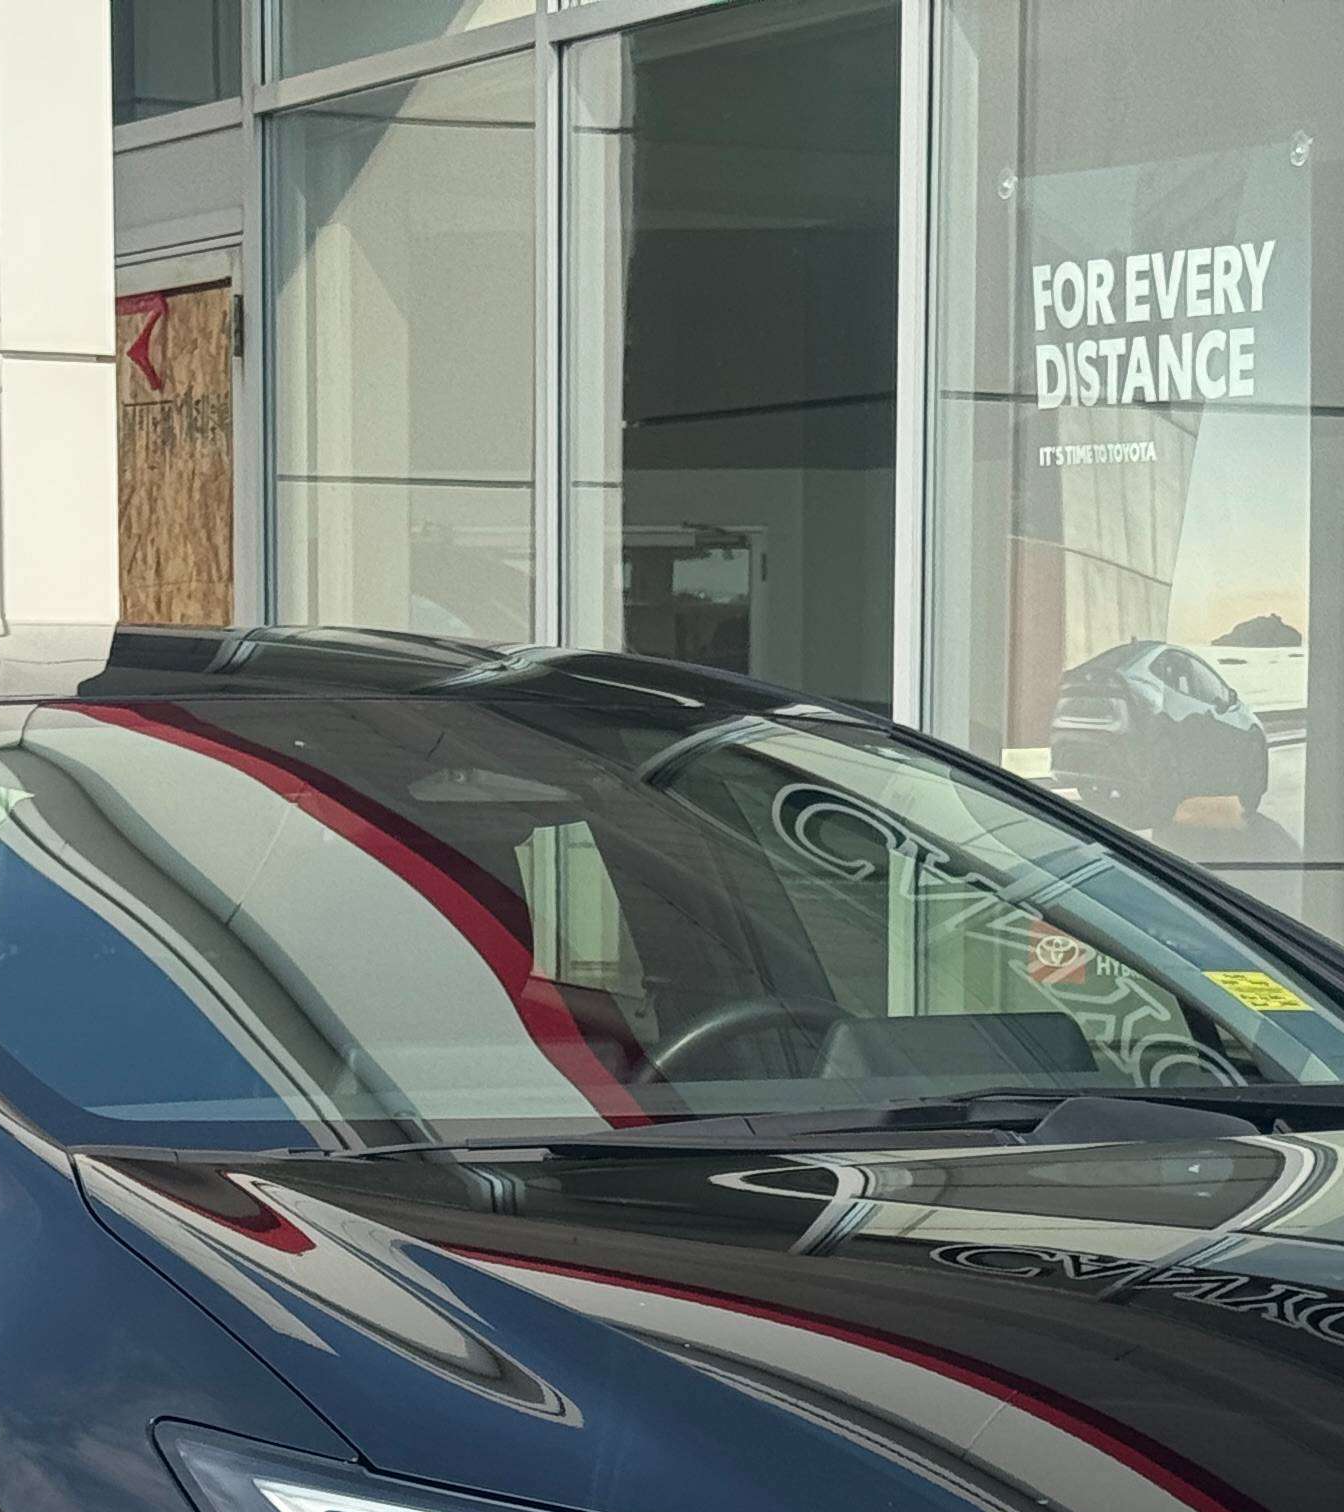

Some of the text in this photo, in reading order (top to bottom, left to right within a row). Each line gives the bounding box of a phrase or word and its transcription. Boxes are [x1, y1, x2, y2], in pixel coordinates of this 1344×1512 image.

[1032, 240, 1276, 331] FOR EVERY
[1035, 327, 1254, 410] DISTANCE
[1039, 441, 1156, 466] IT'S TIME TO TOYOTA
